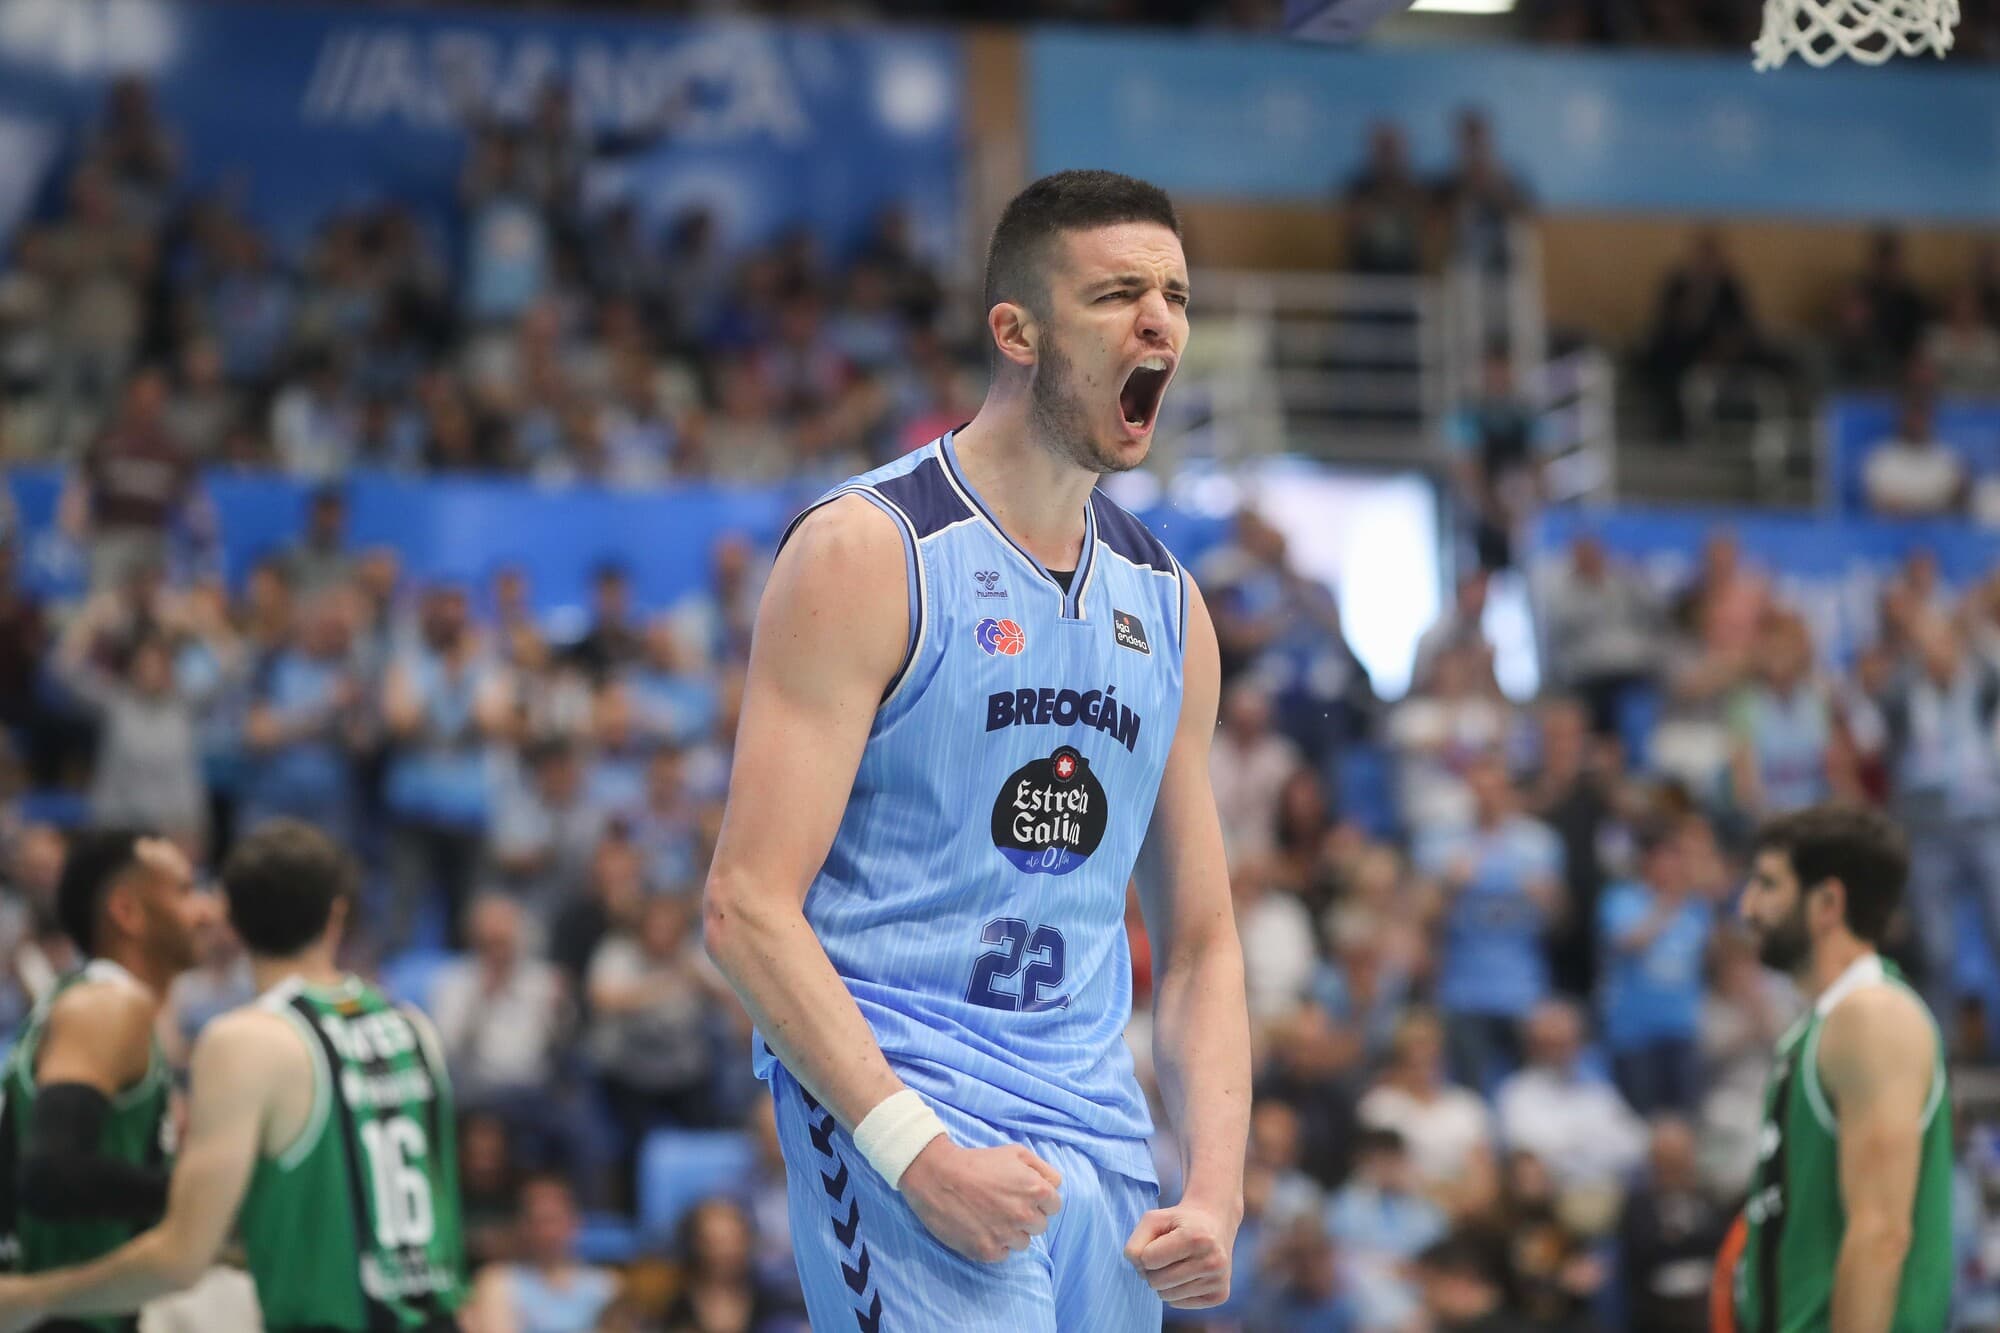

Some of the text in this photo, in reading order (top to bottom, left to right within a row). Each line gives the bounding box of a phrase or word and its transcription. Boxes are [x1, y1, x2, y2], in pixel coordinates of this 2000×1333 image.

[976, 589, 1008, 598] hummel
[1117, 632, 1148, 650] endesa
[986, 685, 1141, 753] BREOGÁN
[964, 917, 1071, 1012] 22
[360, 1115, 436, 1250] 16
